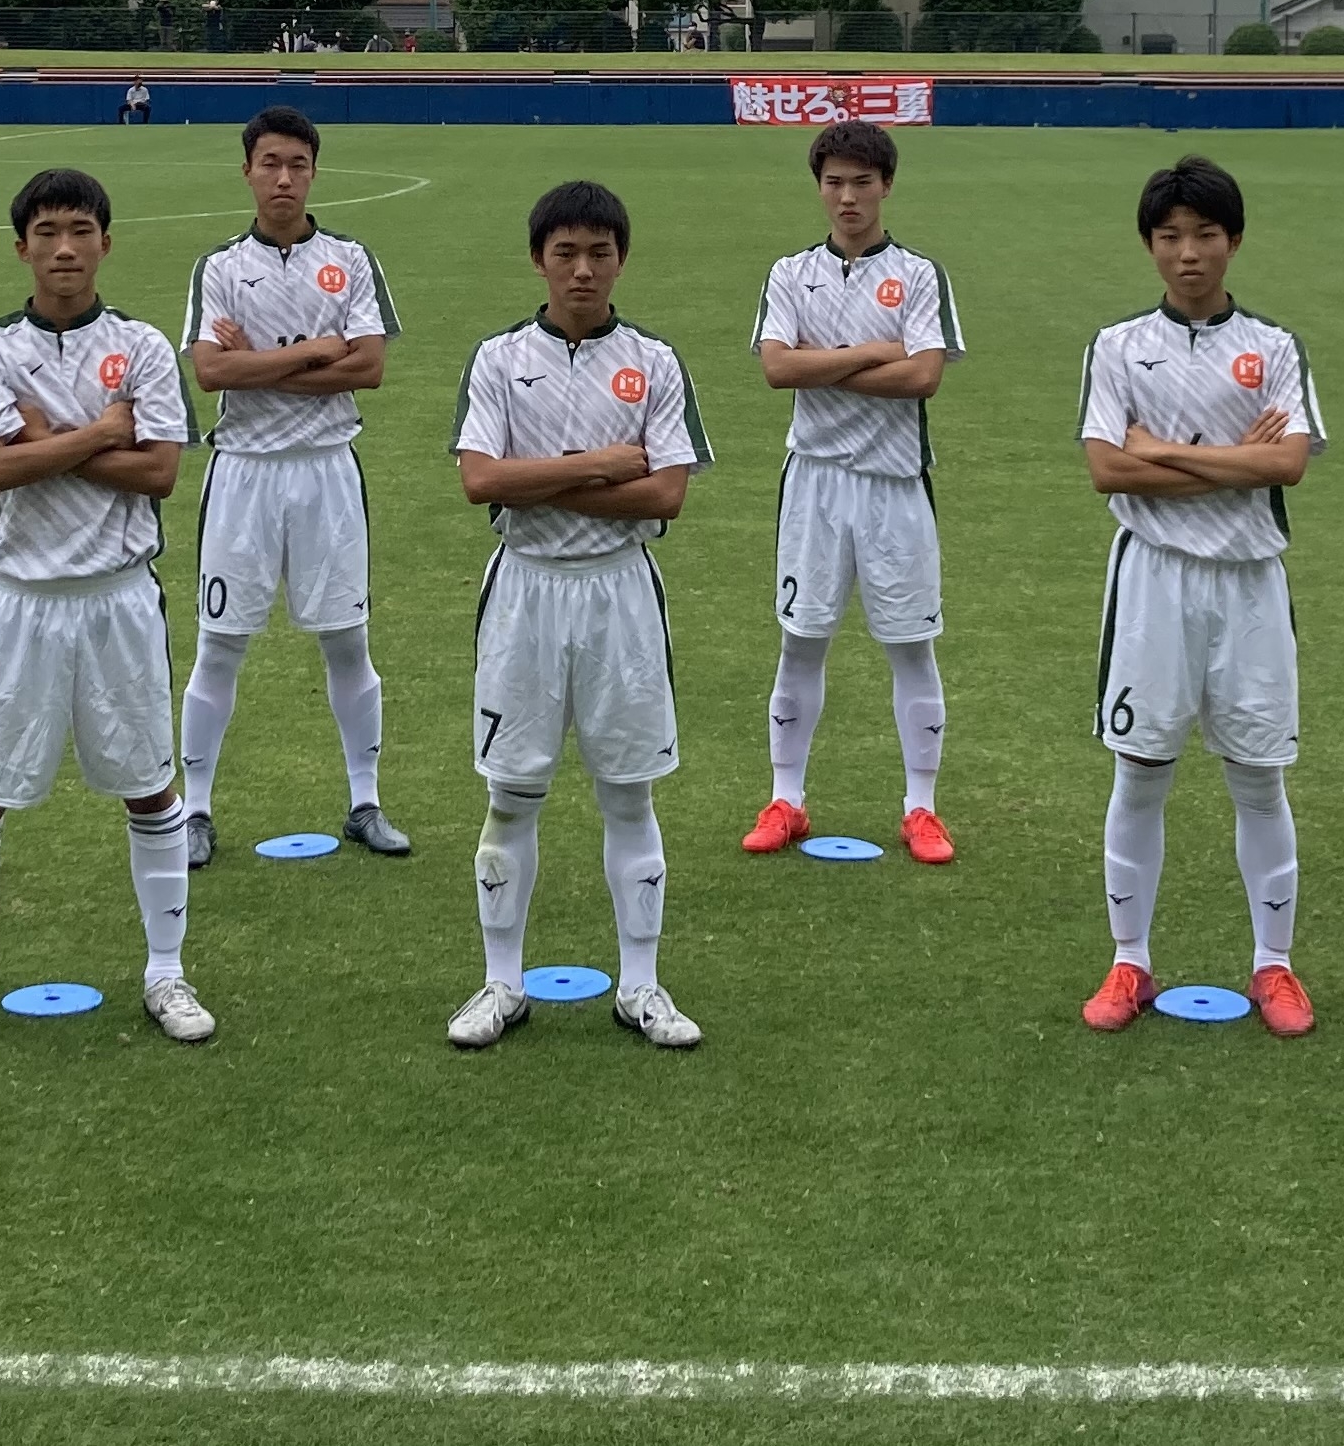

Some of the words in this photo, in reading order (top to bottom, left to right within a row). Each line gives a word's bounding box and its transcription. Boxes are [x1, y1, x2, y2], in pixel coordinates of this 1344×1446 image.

[859, 82, 931, 123] 三重
[782, 575, 797, 618] 2
[480, 707, 502, 758] 7
[1110, 686, 1134, 735] 6
